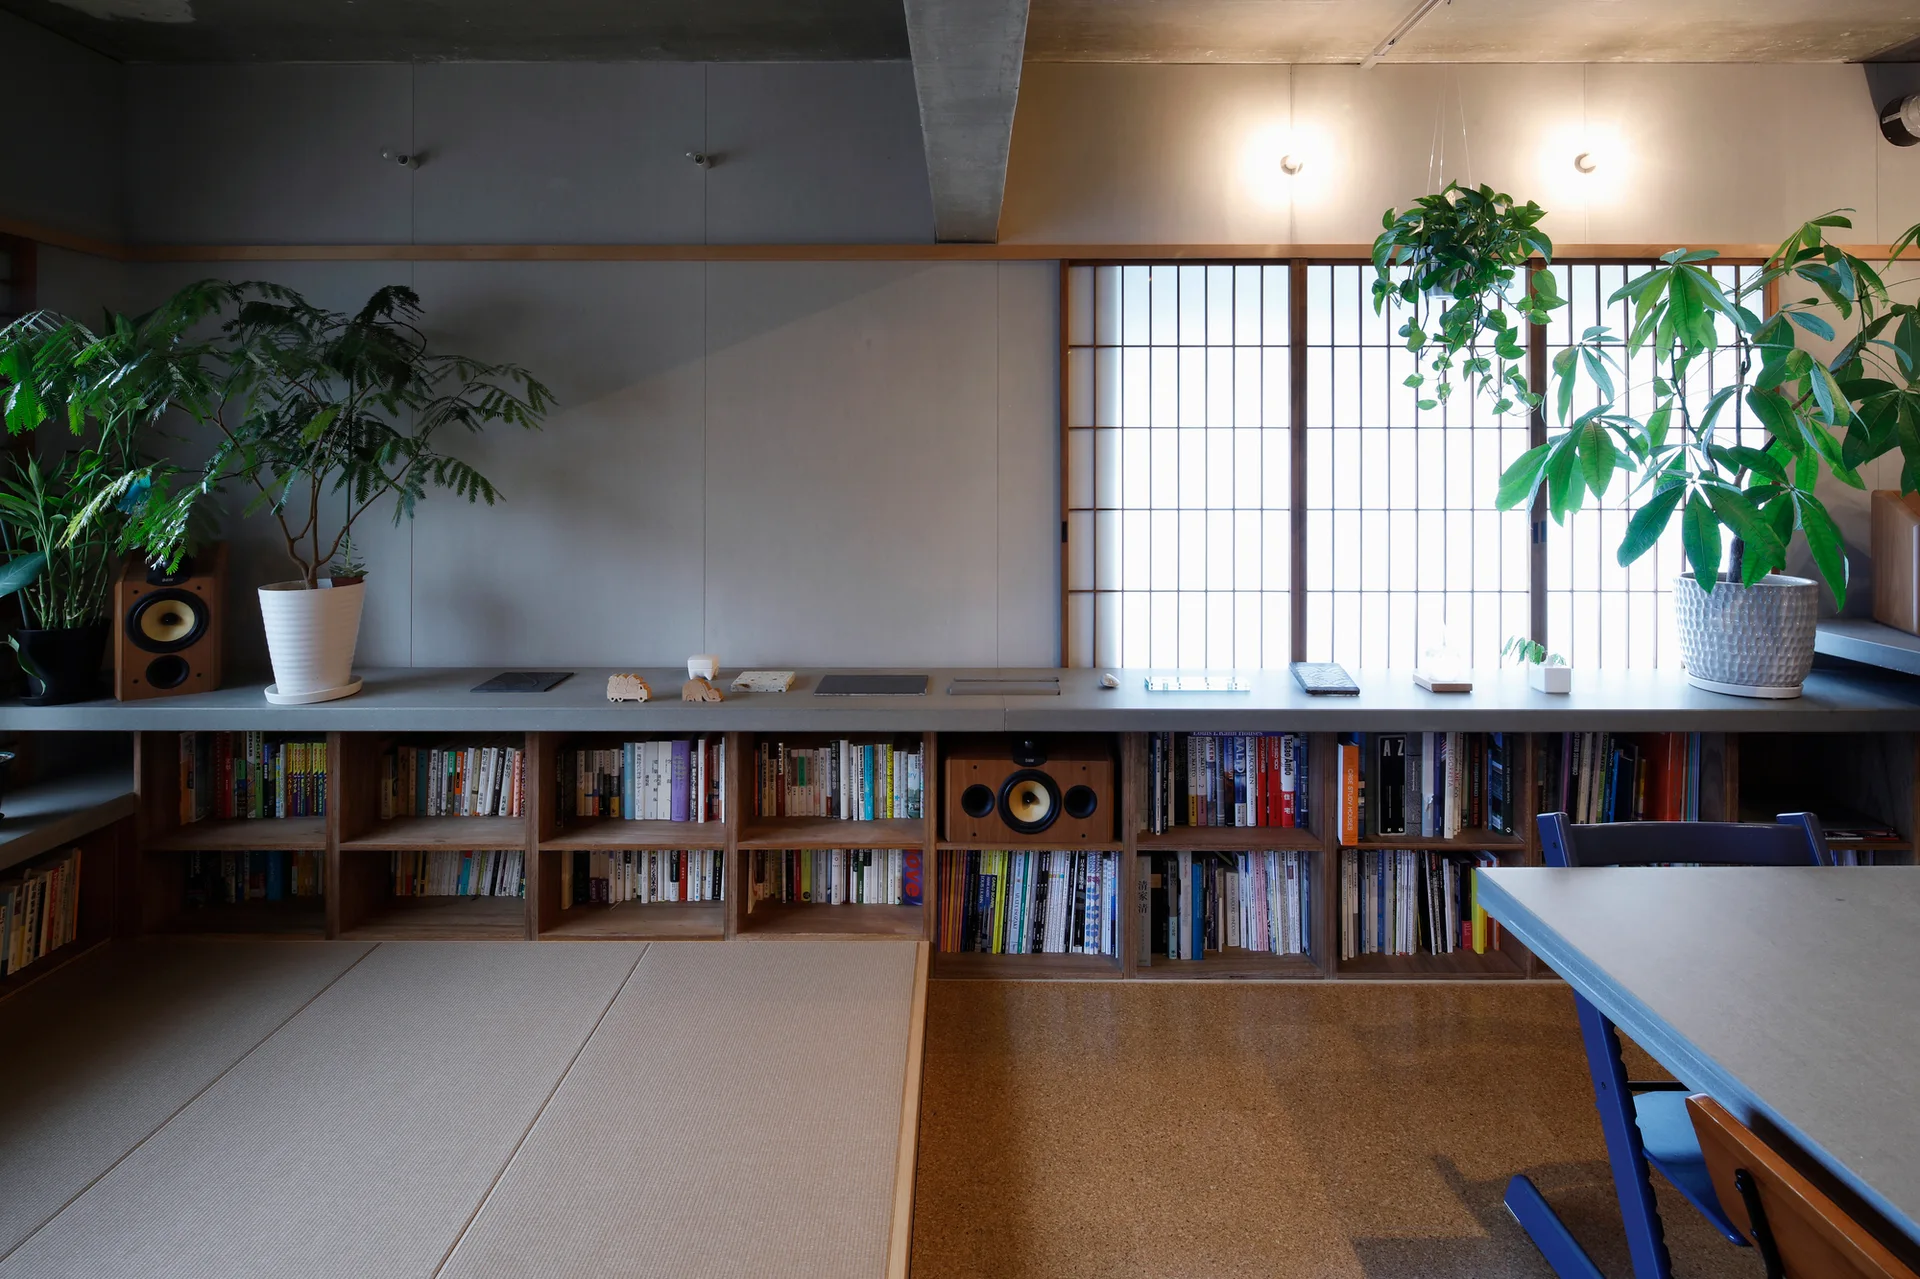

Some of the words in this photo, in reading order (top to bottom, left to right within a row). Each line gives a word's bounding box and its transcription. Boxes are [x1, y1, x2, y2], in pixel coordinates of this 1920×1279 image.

[1236, 736, 1246, 773] AALTO
[1284, 738, 1293, 757] Tadao
[1383, 739, 1392, 757] A
[1397, 739, 1405, 757] Z
[1247, 754, 1255, 785] JACOBSEN
[1284, 758, 1293, 776] Ando
[905, 849, 921, 898] ove
[1138, 880, 1148, 914] 清家清
